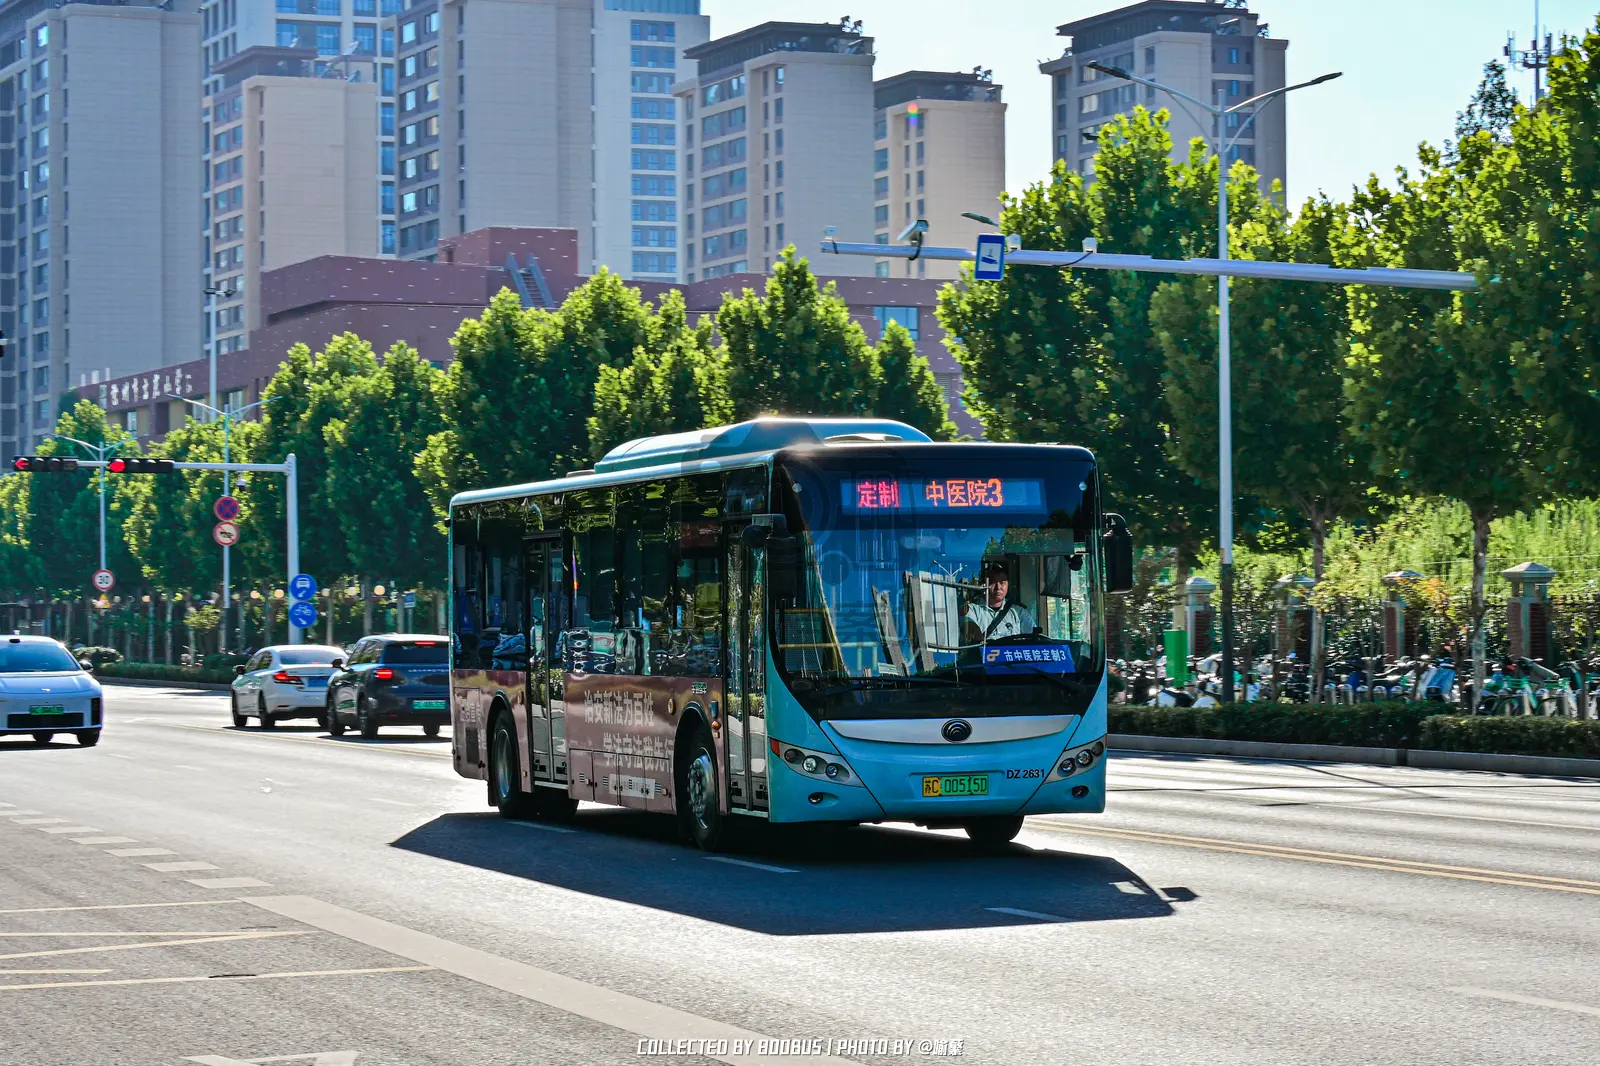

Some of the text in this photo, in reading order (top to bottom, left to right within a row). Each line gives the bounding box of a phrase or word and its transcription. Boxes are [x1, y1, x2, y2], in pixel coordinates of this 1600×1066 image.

[857, 478, 1003, 508] 定制 中医院3
[1003, 648, 1066, 662] 市中医院定制3
[584, 690, 655, 727] 治安新法为百姓
[603, 732, 675, 774] 学法守法我先行
[1006, 769, 1045, 779] DZ 2631
